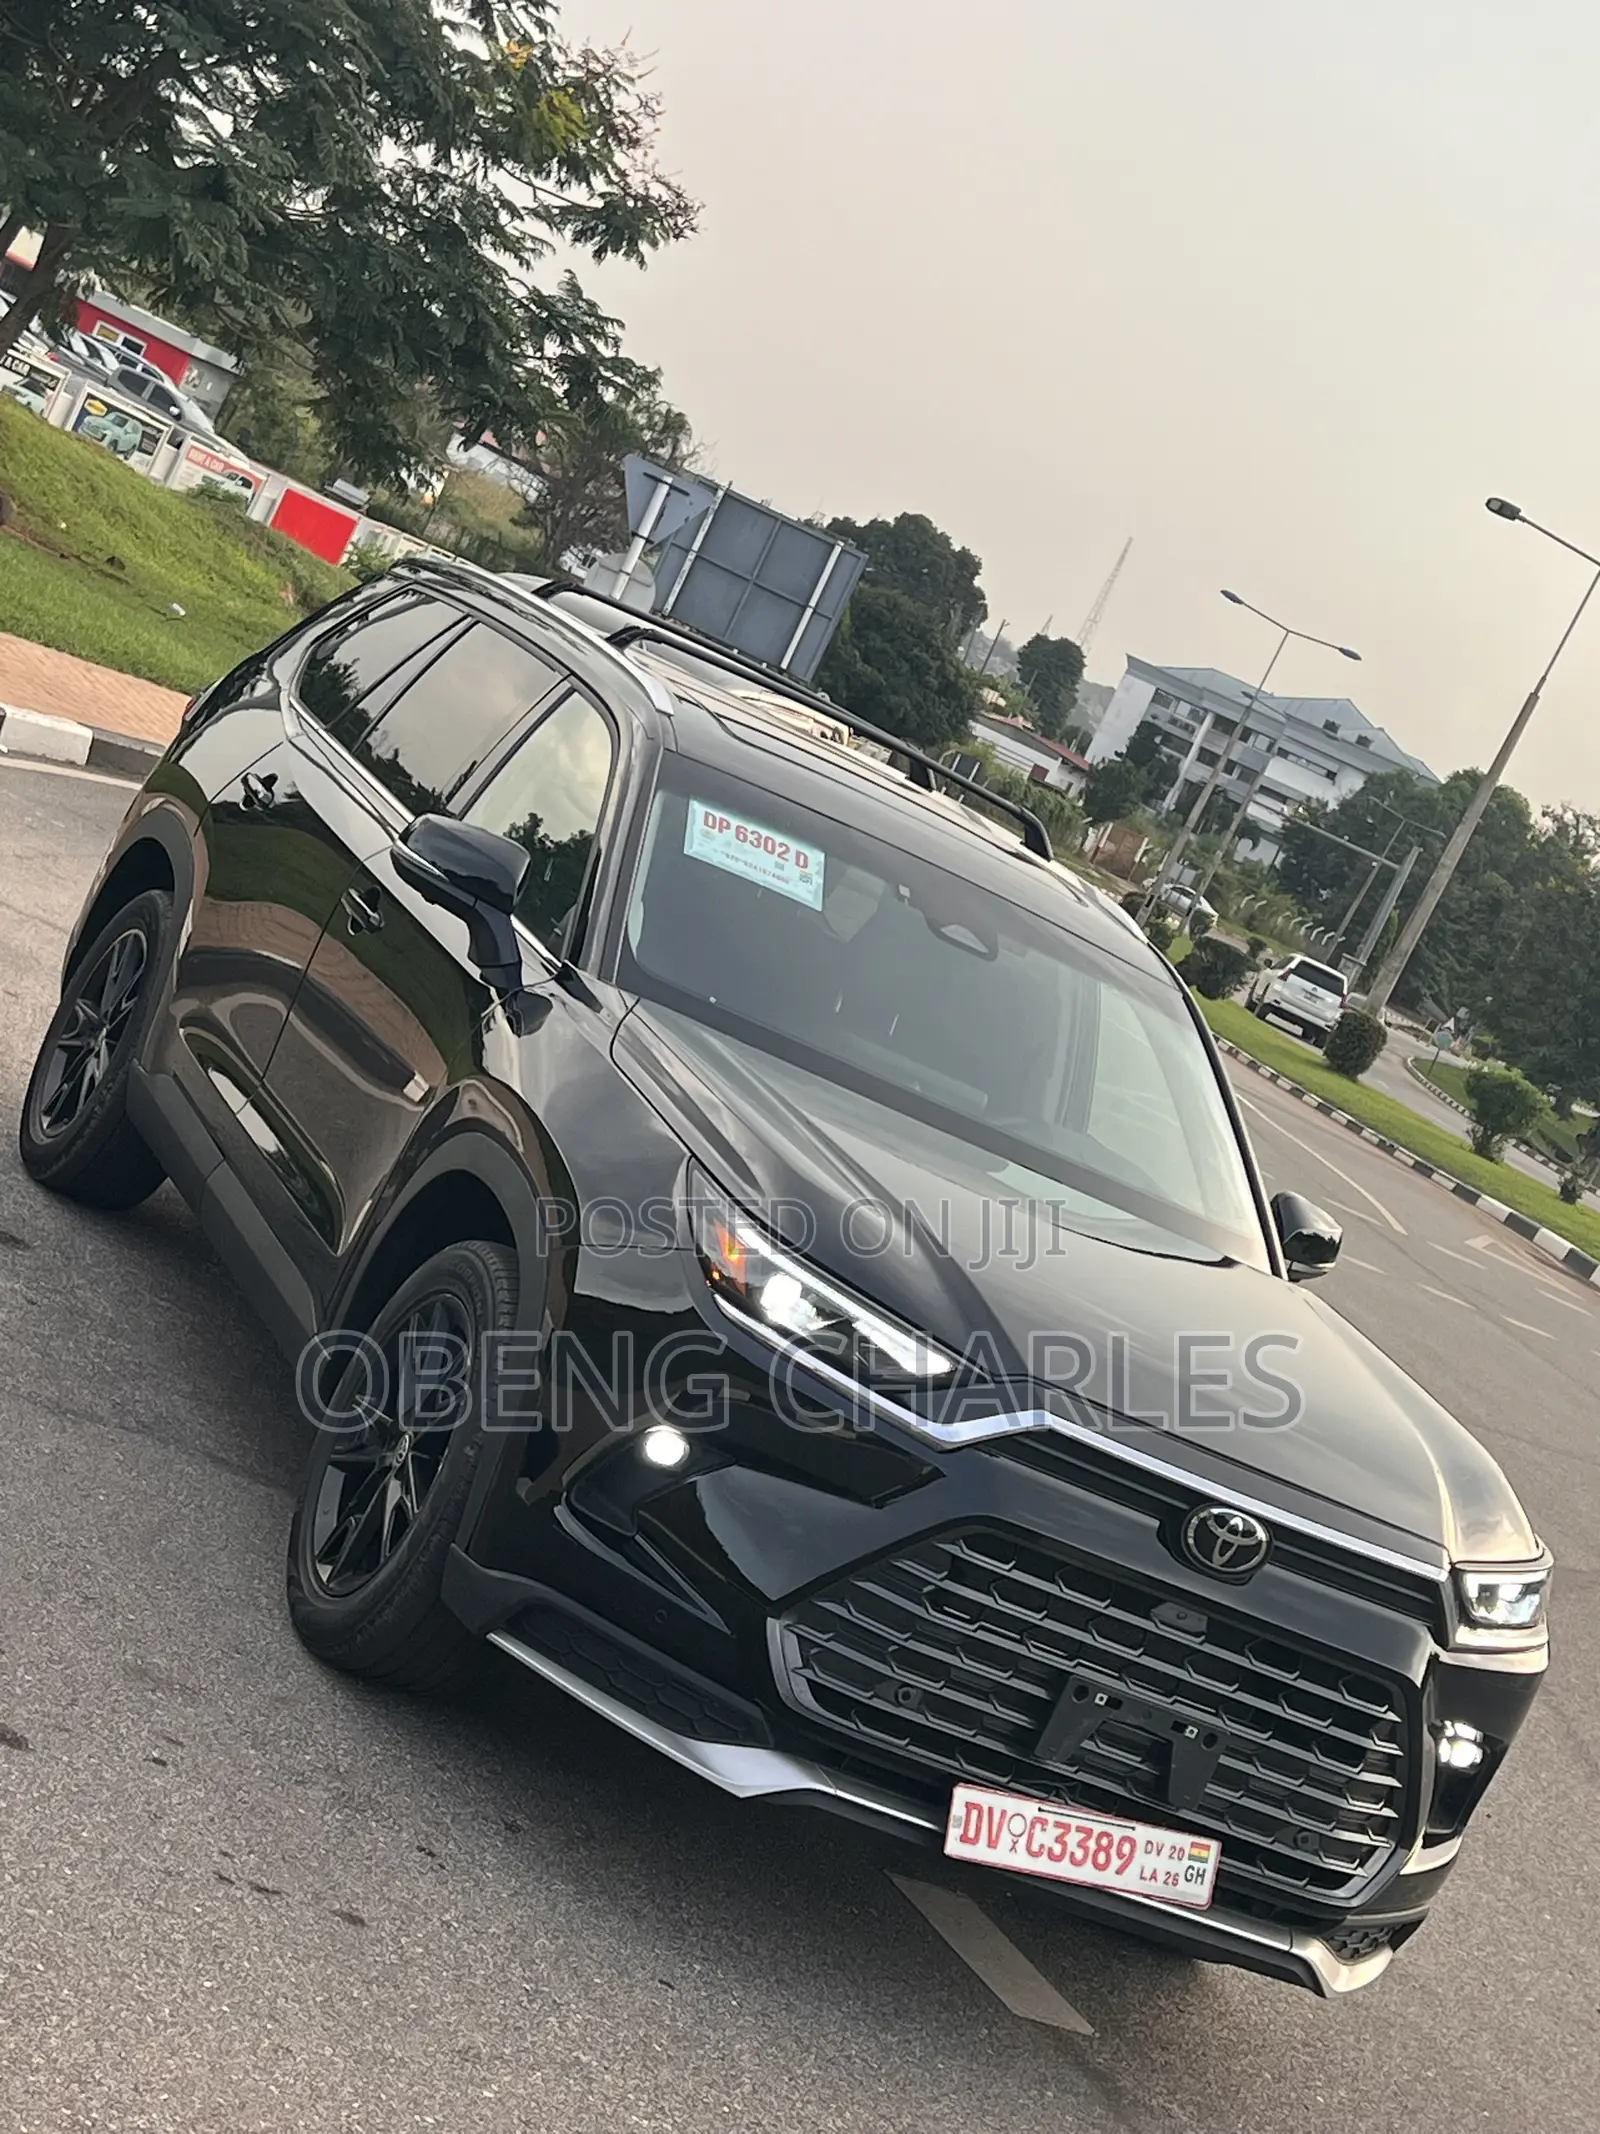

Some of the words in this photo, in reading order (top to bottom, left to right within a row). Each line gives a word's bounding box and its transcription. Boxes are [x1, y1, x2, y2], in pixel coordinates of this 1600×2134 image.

[703, 810, 732, 834] DP
[734, 823, 791, 862] 6302
[795, 848, 809, 869] D
[959, 1801, 1008, 1849] DV
[1025, 1815, 1137, 1876] C3389
[1143, 1840, 1166, 1857] DV
[1168, 1844, 1186, 1862] 20
[1138, 1868, 1159, 1883] LA
[1183, 1865, 1207, 1886] GH
